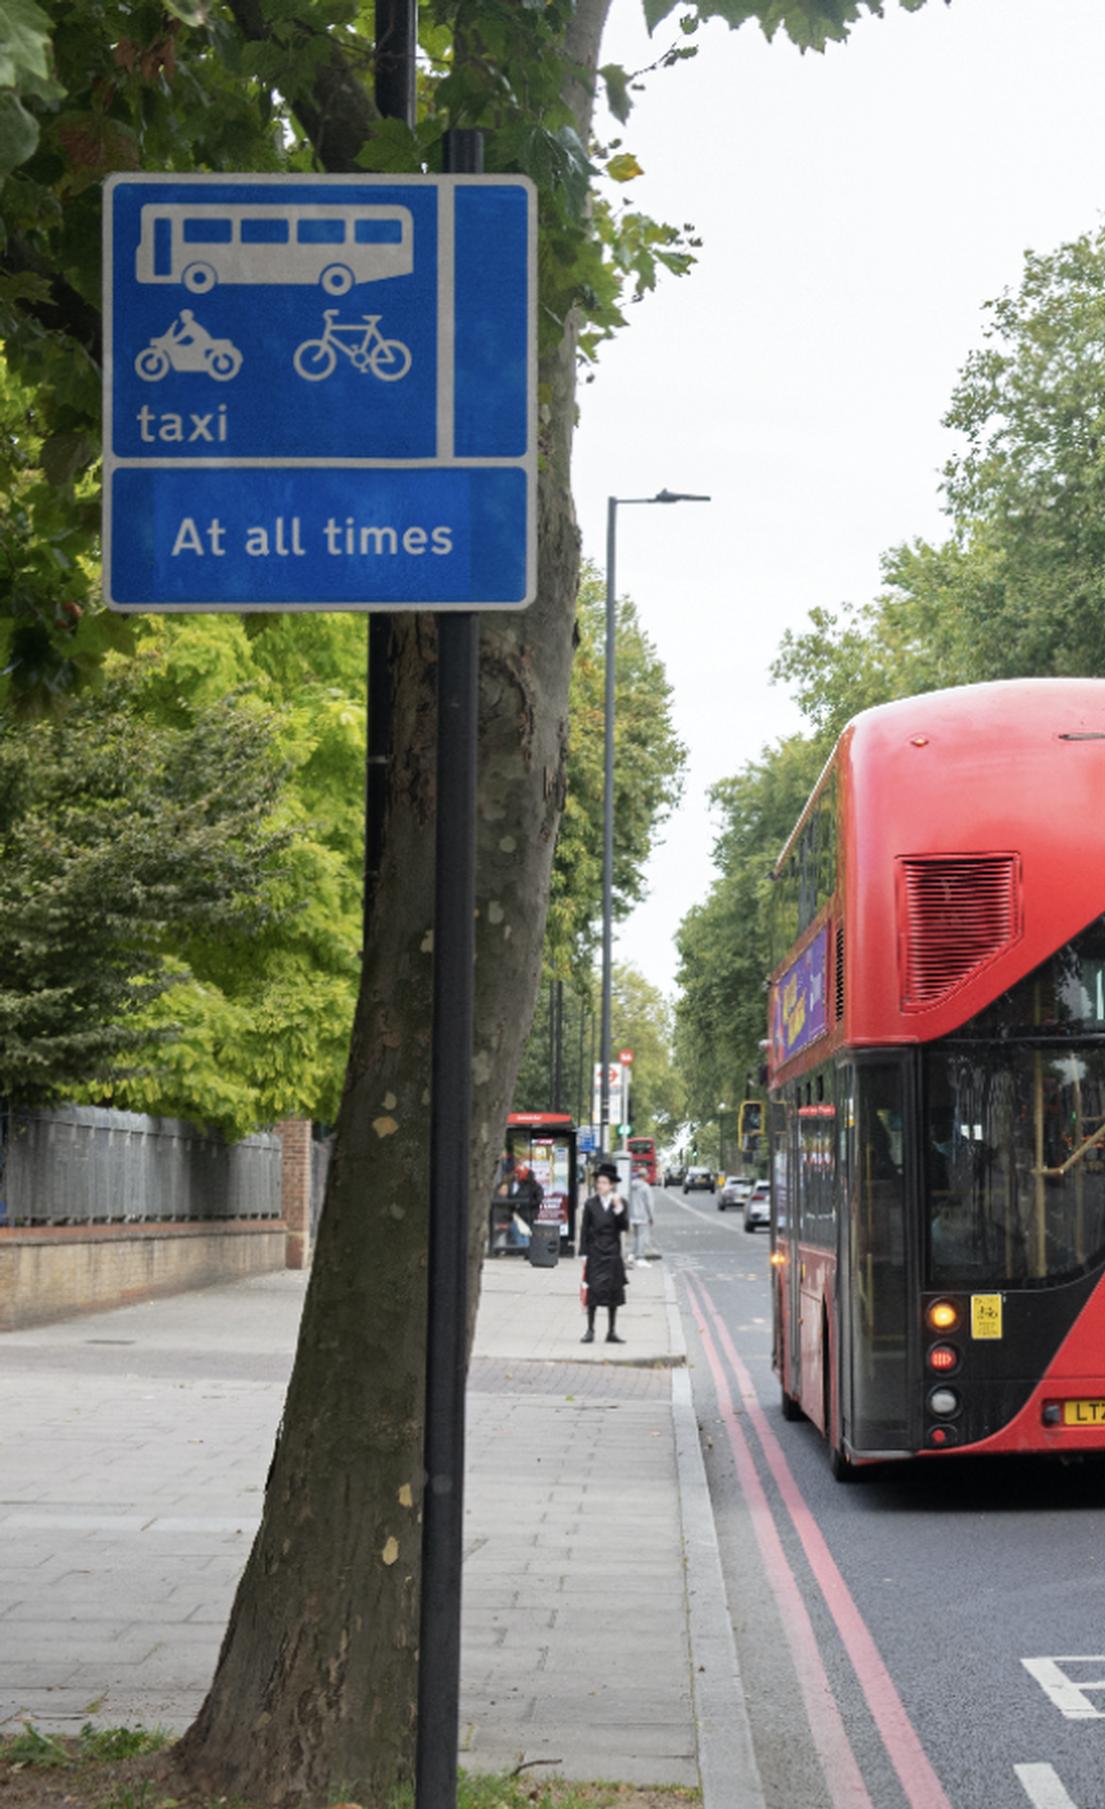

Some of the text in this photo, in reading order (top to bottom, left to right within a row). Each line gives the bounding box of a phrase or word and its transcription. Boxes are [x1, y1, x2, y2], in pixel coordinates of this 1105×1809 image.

[136, 405, 227, 442] taxi
[172, 517, 453, 556] At all times
